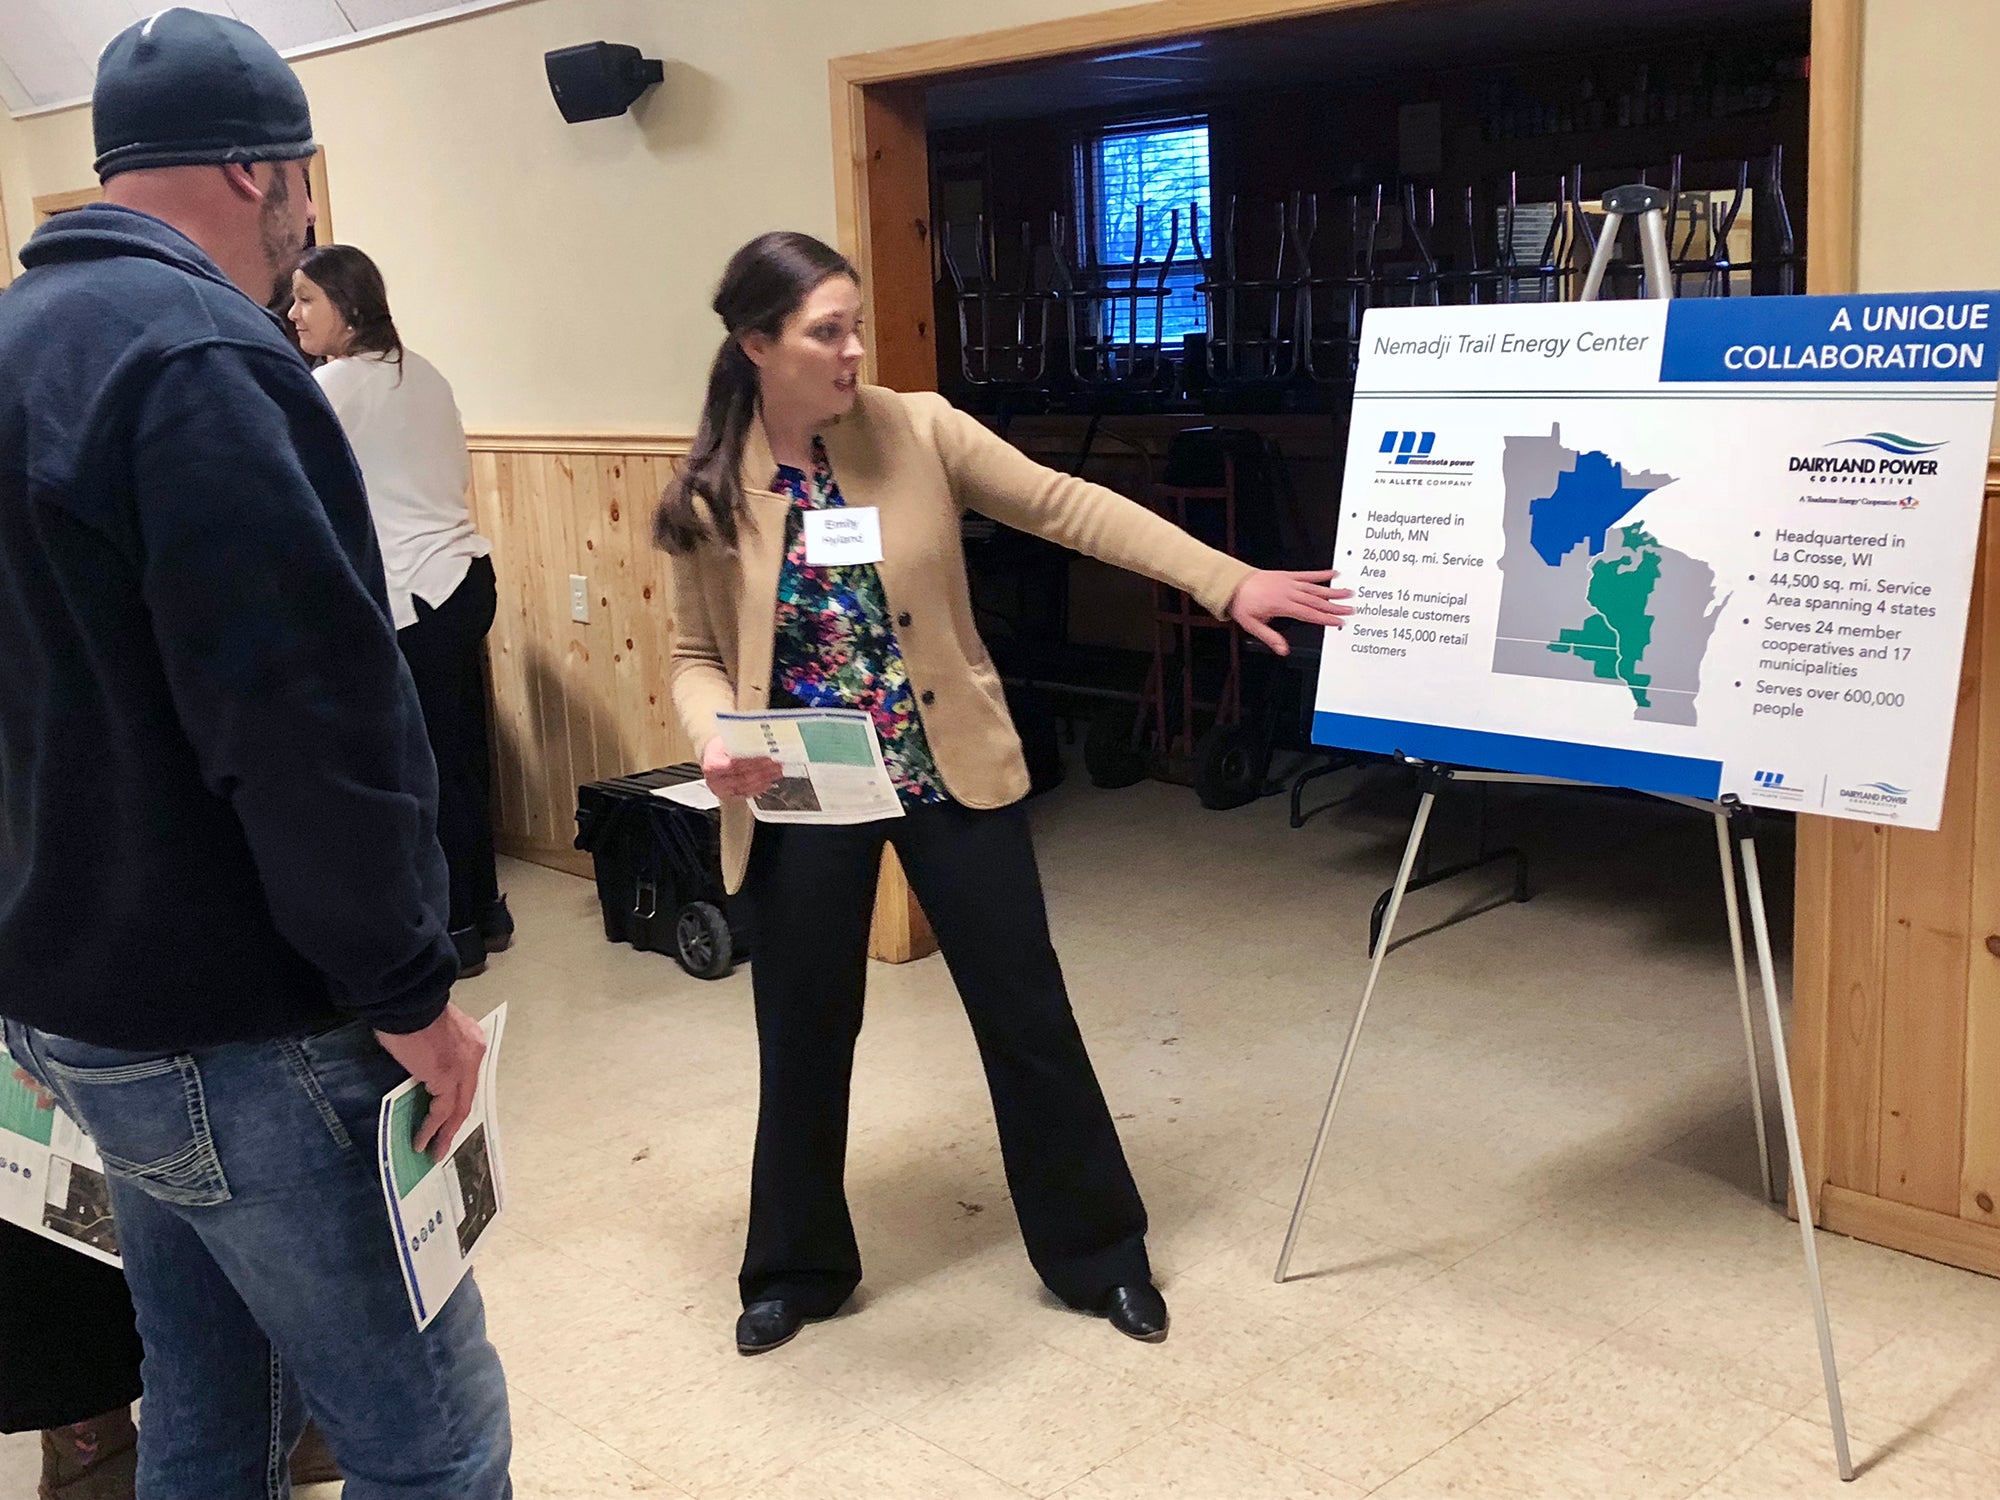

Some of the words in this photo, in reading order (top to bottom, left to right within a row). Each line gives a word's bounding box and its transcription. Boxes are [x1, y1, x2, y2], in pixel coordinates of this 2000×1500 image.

[1829, 307, 1853, 332] A
[1862, 303, 1990, 331] UNIQUE
[1374, 336, 1452, 359] Nemadji
[1458, 333, 1496, 353] Trail
[1501, 333, 1570, 358] Energy
[1576, 331, 1649, 352] Center
[1724, 342, 1985, 369] COLLABORATION
[1788, 456, 1876, 473] DAIRYLAND
[1878, 459, 1938, 475] POWER
[1389, 478, 1423, 486] ALLETE
[1426, 479, 1472, 487] COMPANY
[1809, 475, 1913, 485] COOPERATIVE
[1367, 510, 1451, 526] Headquartered
[1454, 514, 1465, 526] in
[1365, 527, 1405, 542] Duluth,
[1408, 529, 1429, 542] MN
[1775, 529, 1889, 547] Headquartered
[1892, 534, 1906, 548] in
[1362, 548, 1400, 562] 26,000
[1402, 553, 1418, 565] sq.
[1422, 552, 1439, 564] mi.
[1442, 552, 1484, 567] Service
[1773, 548, 1790, 562] La
[1793, 549, 1848, 567] Crosse,
[1852, 552, 1873, 566] WI
[1360, 565, 1386, 578] Area
[1769, 573, 1820, 589] 44,500
[1822, 579, 1844, 593] sq.
[1849, 578, 1872, 592] mi.
[1876, 579, 1932, 596] Service
[1358, 586, 1393, 600] Serves
[1398, 589, 1410, 601] 16
[1413, 593, 1468, 607] municipal
[1767, 593, 1801, 607] Area
[1805, 597, 1872, 616] spanning
[1876, 600, 1886, 613] 4
[1890, 603, 1937, 617] states
[1355, 603, 1409, 618] wholesale
[1412, 610, 1471, 624] customers
[1353, 624, 1389, 638] Serves
[1392, 627, 1436, 643] 145,000
[1439, 633, 1469, 645] retail
[1764, 616, 1811, 633] Serves
[1815, 620, 1834, 634] 24
[1838, 624, 1902, 640] member
[1351, 643, 1407, 657] customers
[1761, 639, 1855, 657] cooperatives
[1858, 646, 1888, 660] and
[1893, 647, 1912, 661] 17
[1759, 658, 1858, 677] municipalities
[1756, 680, 1803, 697] Serves
[1807, 688, 1840, 700] over
[1843, 689, 1905, 707] 600,000
[1752, 702, 1804, 718] people
